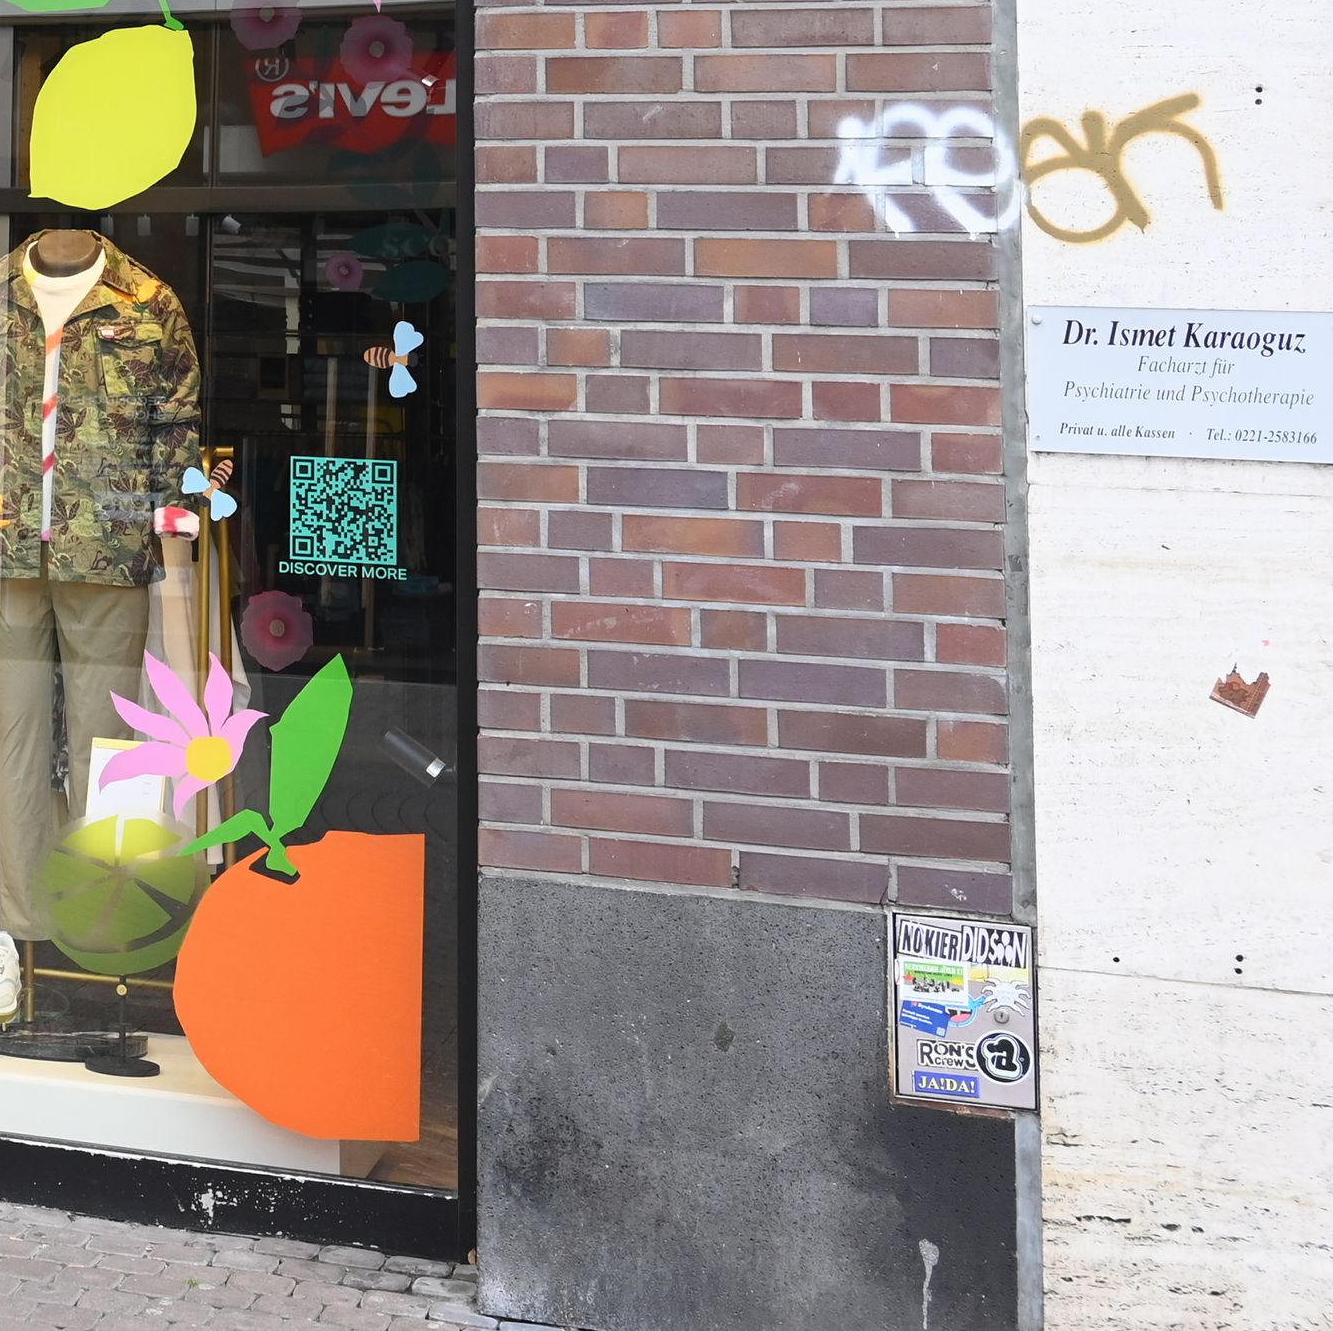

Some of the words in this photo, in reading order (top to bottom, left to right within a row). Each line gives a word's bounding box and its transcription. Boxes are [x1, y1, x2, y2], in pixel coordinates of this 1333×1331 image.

[1062, 320, 1097, 346] Dr.
[1107, 321, 1176, 348] Ismet
[1183, 322, 1307, 357] Karaoguz
[1138, 355, 1207, 375] Facharzt
[1209, 357, 1235, 378] für
[1064, 380, 1151, 402] Psychiatrie
[1156, 385, 1185, 403] und
[1191, 385, 1315, 409] Psychotherapie
[1060, 423, 1093, 436] Privat
[1097, 427, 1107, 437] u.
[1111, 424, 1132, 438] alle
[1134, 426, 1175, 439] Kassen
[1235, 430, 1318, 445] 0221-2583166
[279, 561, 358, 578] DISCOVER
[362, 565, 408, 581] MORE
